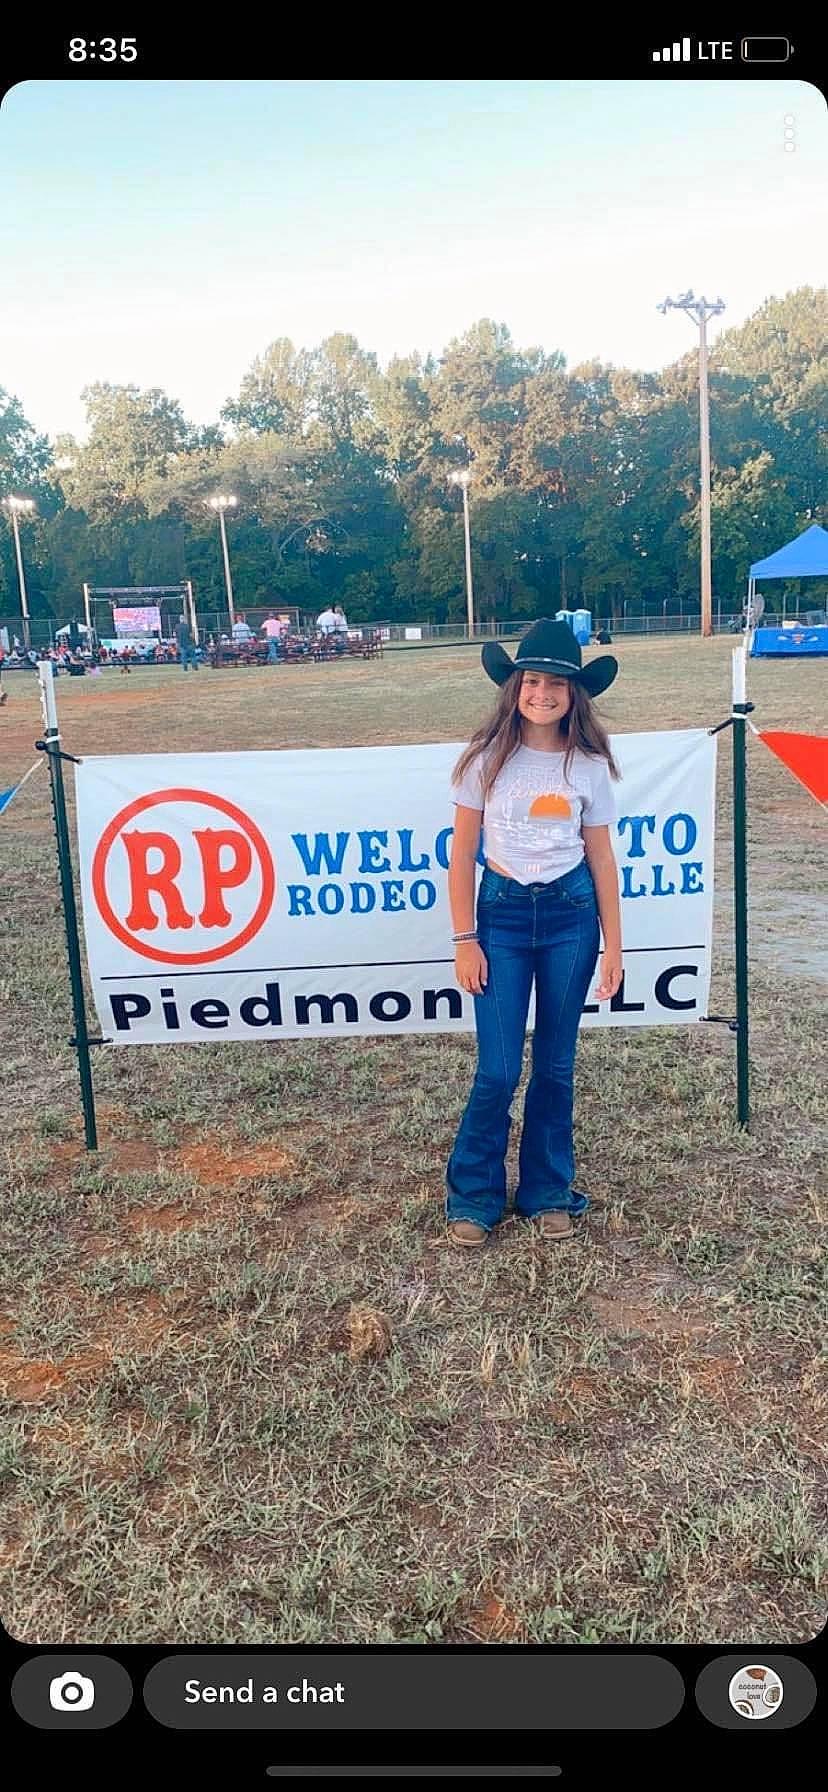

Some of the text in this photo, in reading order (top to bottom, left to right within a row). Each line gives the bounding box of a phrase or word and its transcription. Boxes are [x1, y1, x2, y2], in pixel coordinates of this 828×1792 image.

[616, 812, 698, 858] TO
[120, 827, 252, 931] RP
[286, 878, 438, 918] RODEO
[109, 982, 463, 1031] Piedmon
